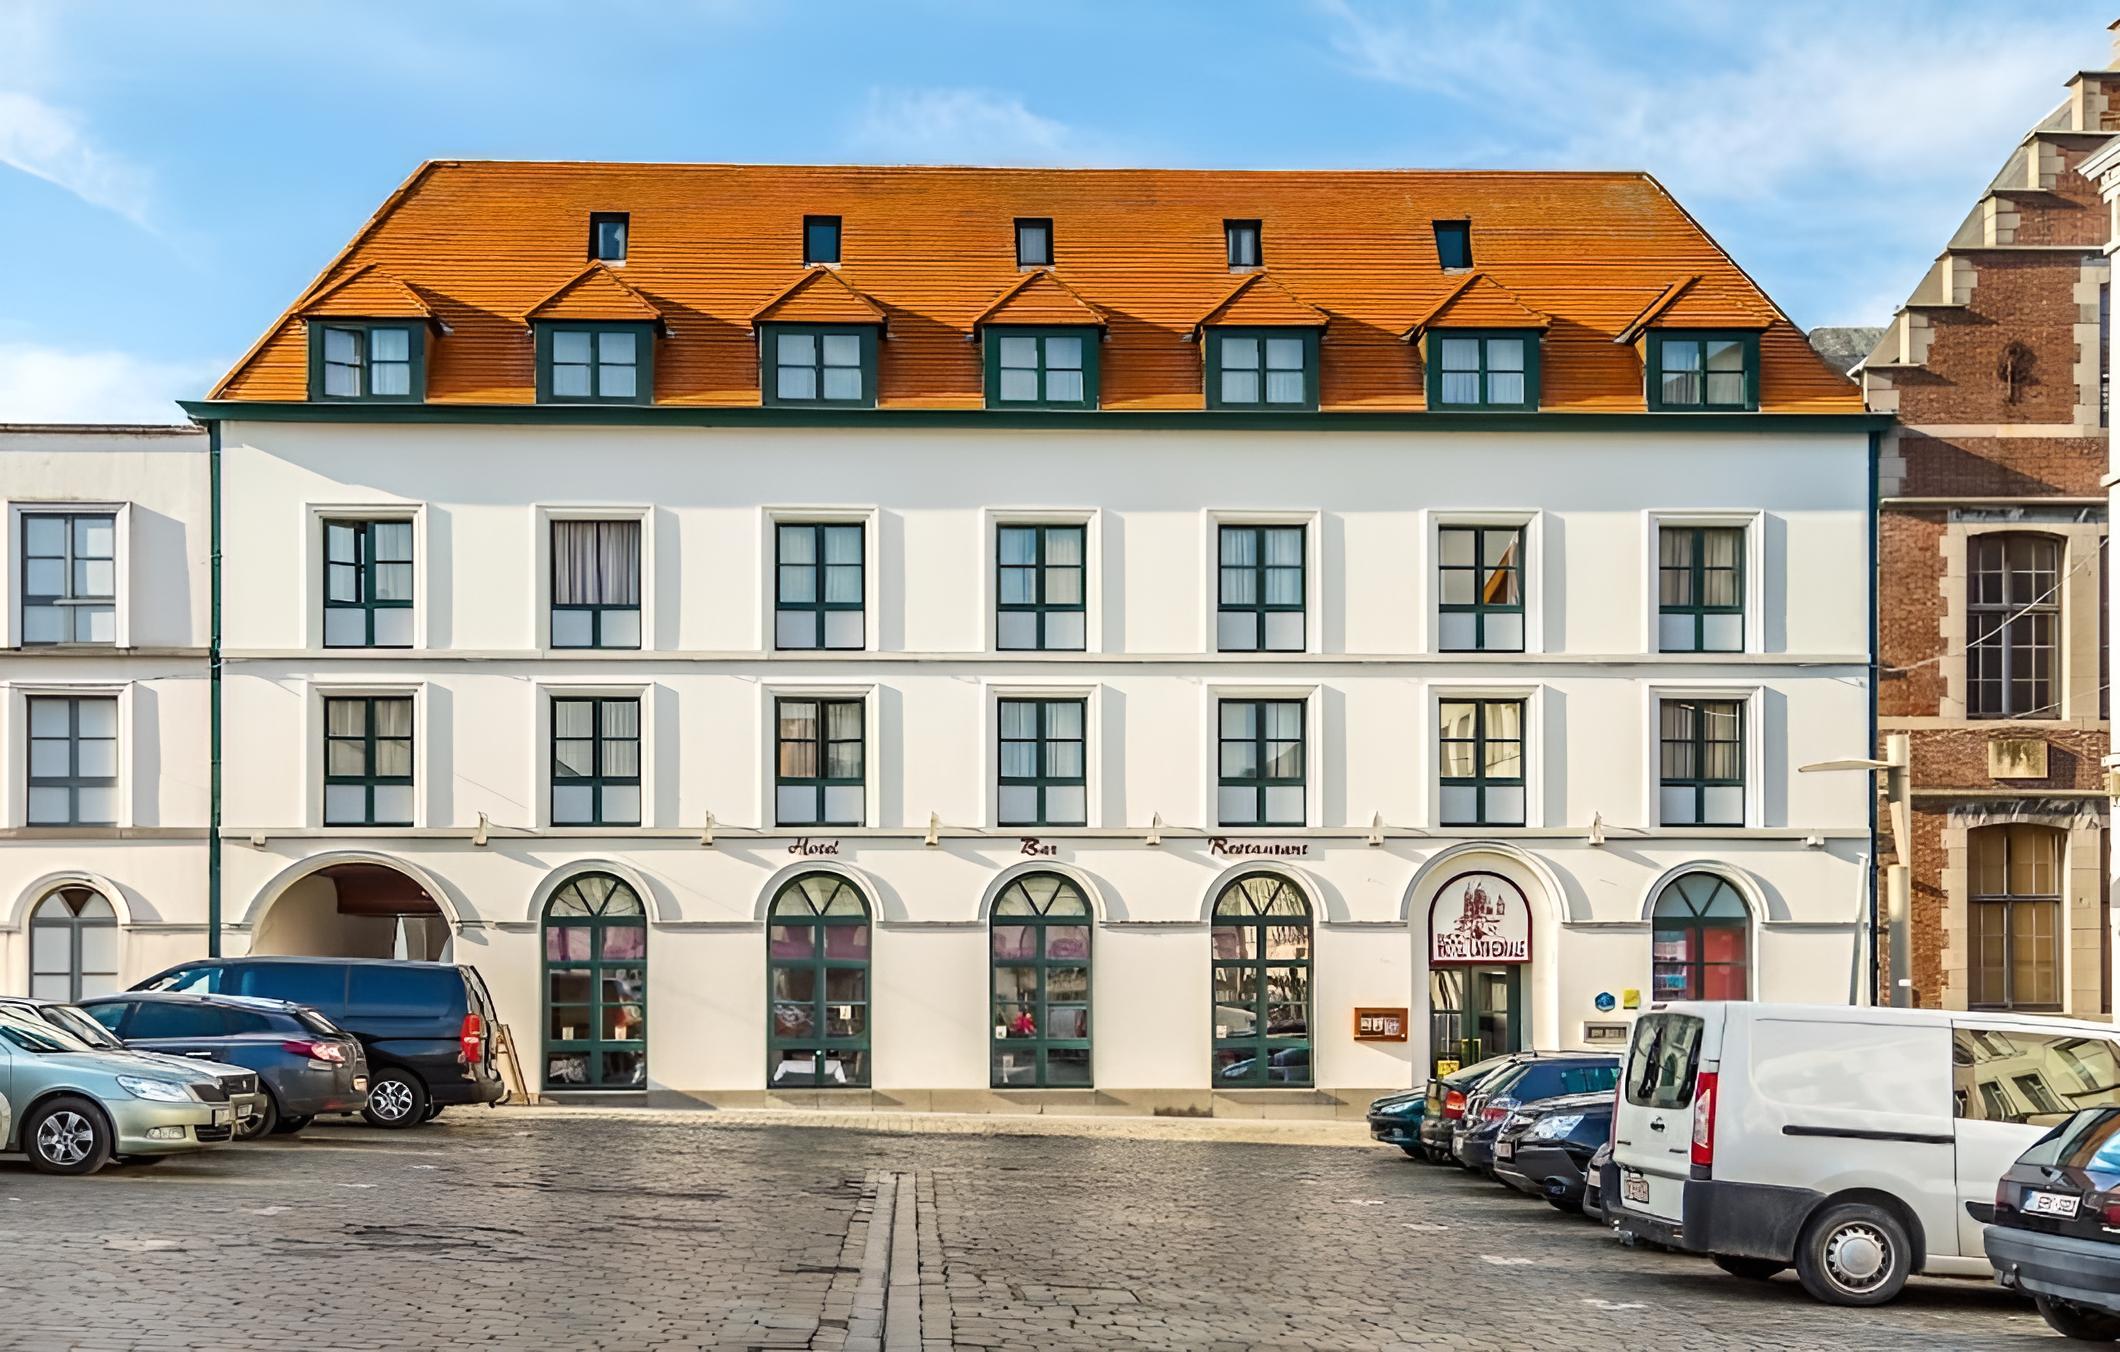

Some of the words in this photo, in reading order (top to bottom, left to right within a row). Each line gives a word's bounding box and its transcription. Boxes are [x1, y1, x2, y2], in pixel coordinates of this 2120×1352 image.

[788, 837, 839, 855] Hotel
[1021, 837, 1057, 856] Bar
[1208, 837, 1308, 855] Restaurant
